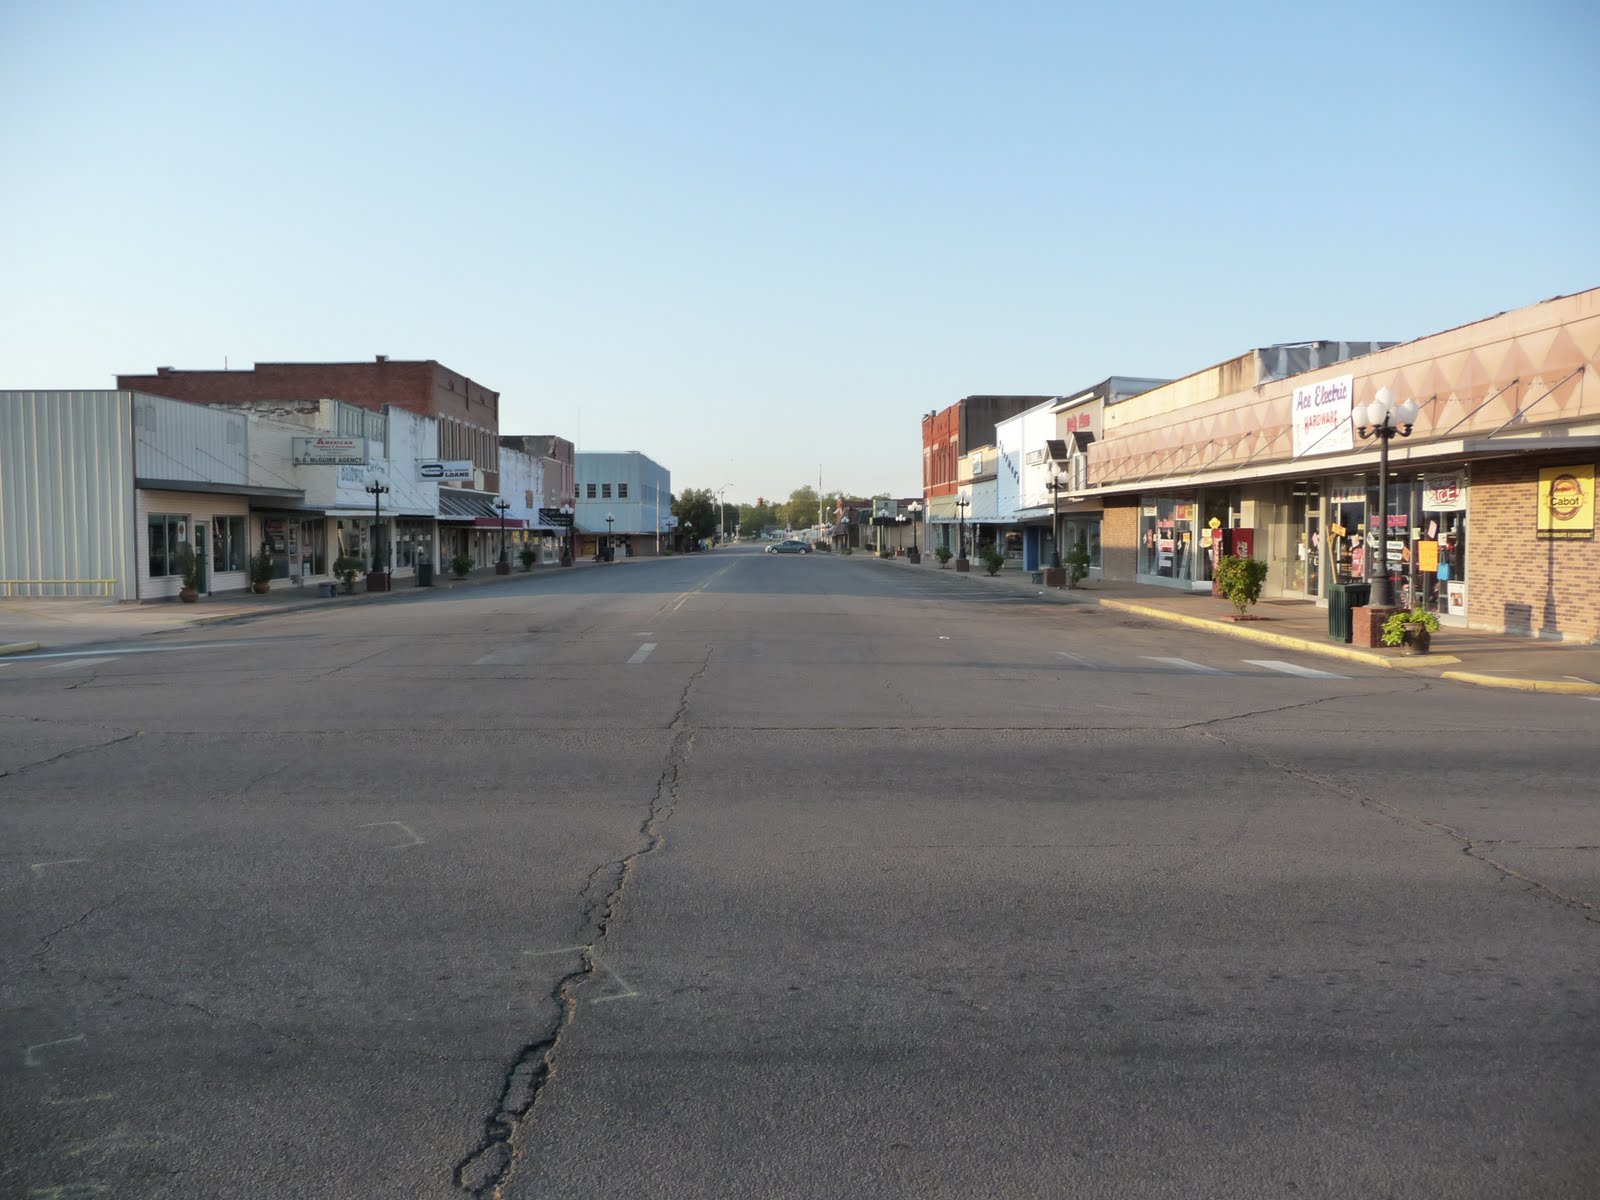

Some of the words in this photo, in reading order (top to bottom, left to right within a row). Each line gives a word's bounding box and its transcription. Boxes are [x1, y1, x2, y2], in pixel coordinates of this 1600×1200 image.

[1296, 391, 1311, 411] Ace
[1314, 382, 1348, 407] Electric
[1304, 410, 1338, 432] HARDWARE
[1434, 485, 1457, 503] ICE
[1550, 496, 1580, 506] Cabot
